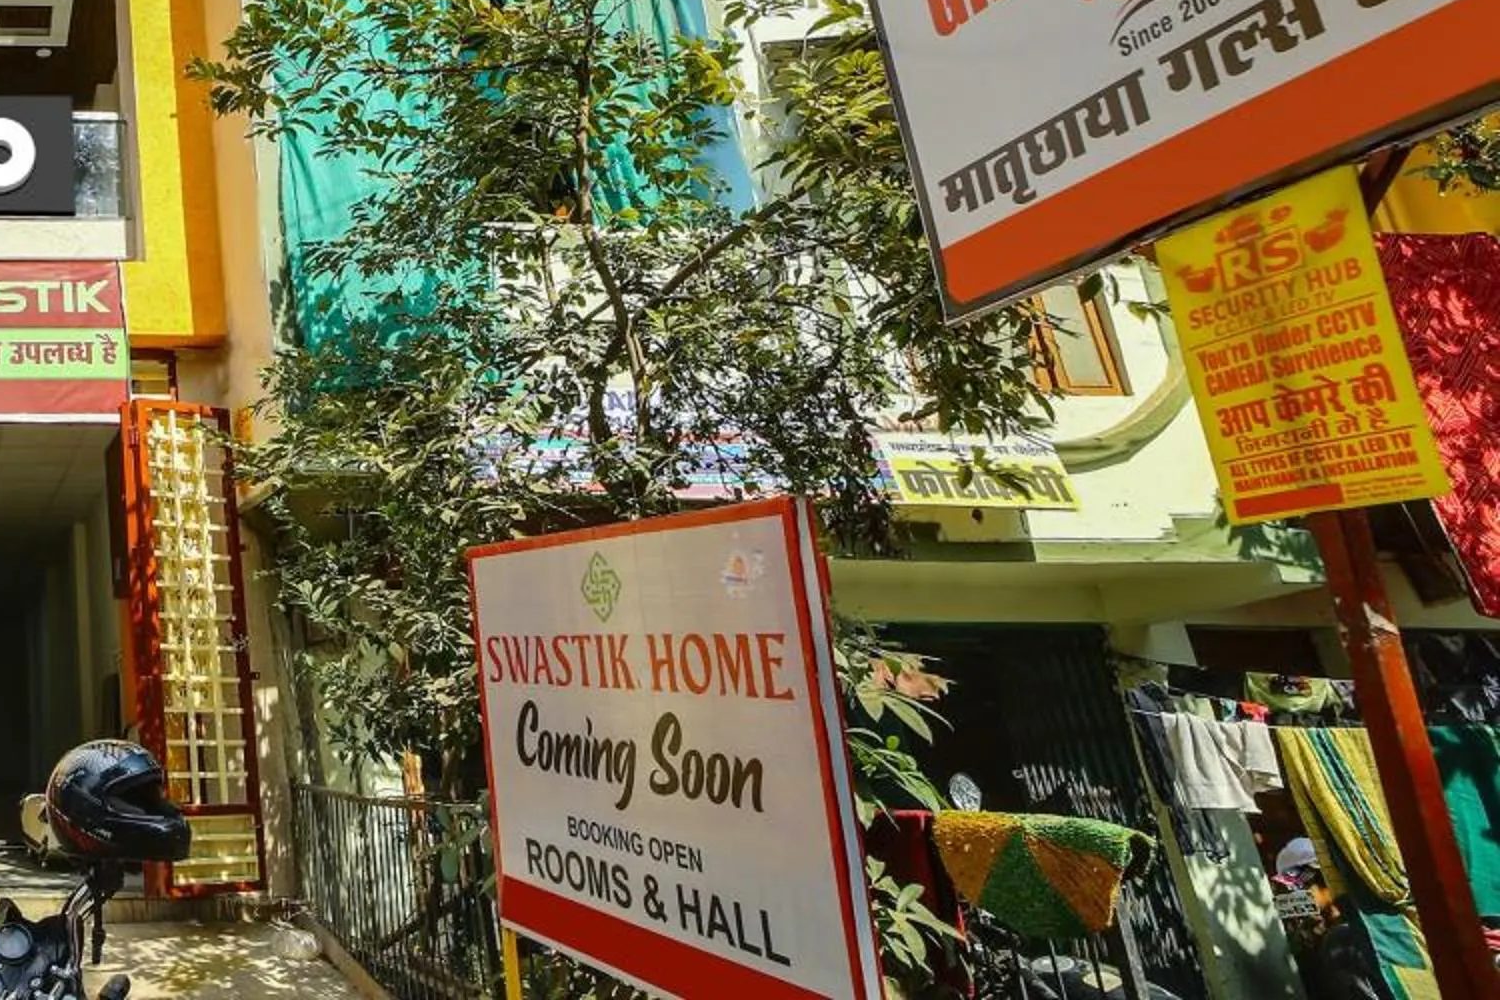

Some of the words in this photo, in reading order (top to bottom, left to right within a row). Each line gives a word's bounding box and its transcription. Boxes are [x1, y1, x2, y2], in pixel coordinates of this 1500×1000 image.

[1118, 13, 1173, 57] Since
[939, 68, 1151, 213] मातृछाया
[1188, 277, 1297, 330] SECURITY
[1307, 257, 1362, 292] HUB
[9, 341, 94, 365] उपलब्ध
[95, 333, 119, 365] है
[1252, 323, 1314, 355] Under
[1316, 301, 1376, 339] CCTV
[1204, 360, 1270, 397] CAMERA
[1216, 398, 1271, 438] आप
[1348, 362, 1397, 406] की
[1392, 431, 1413, 449] TV
[487, 633, 636, 690] SWASTIK
[645, 633, 795, 700] HOME
[517, 700, 637, 811] Coming
[649, 711, 765, 813] Soon
[567, 815, 644, 857] BOOKING
[649, 836, 704, 873] OPEN
[525, 837, 633, 909] ROOMS
[643, 874, 668, 921] &
[676, 882, 791, 967] HALL
